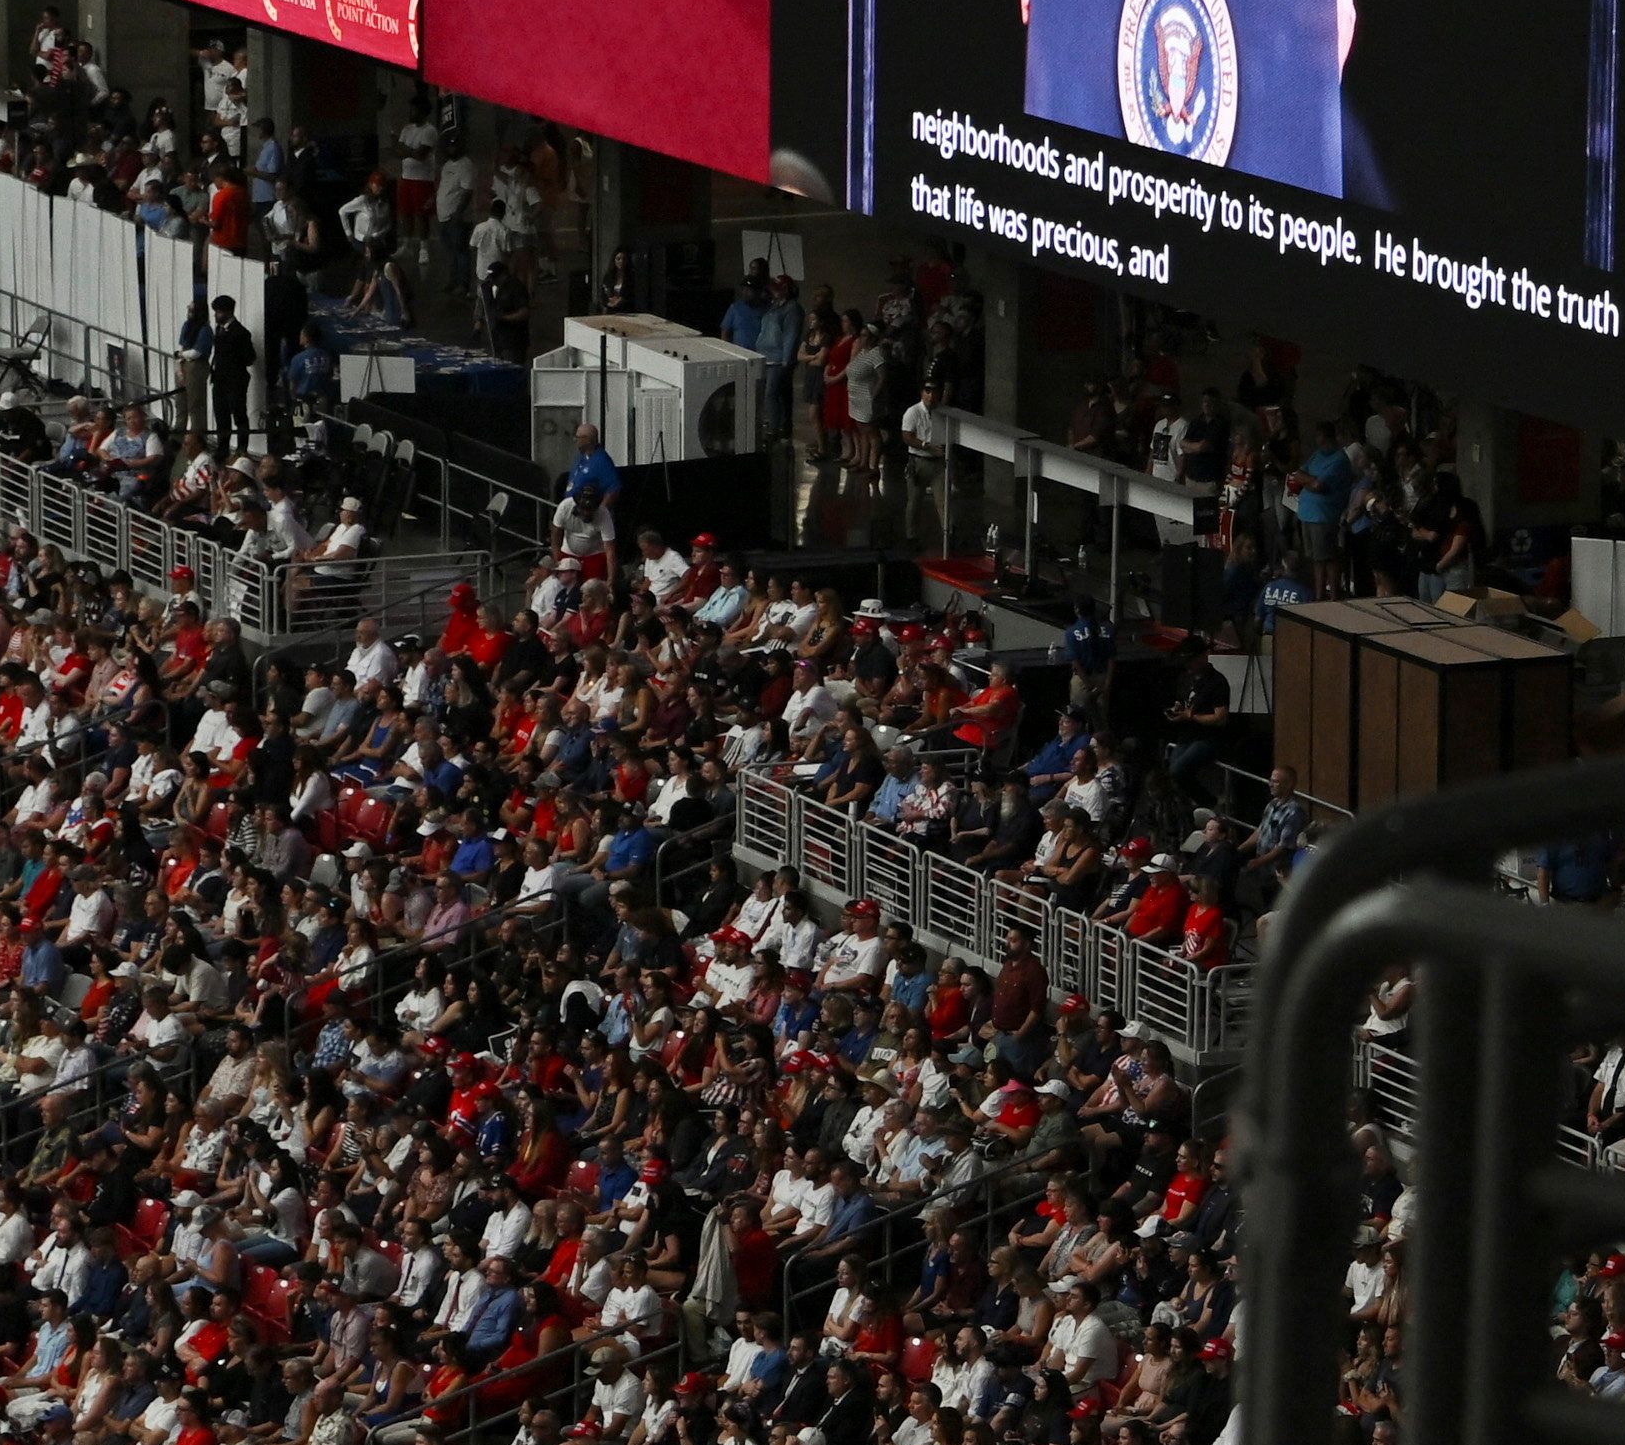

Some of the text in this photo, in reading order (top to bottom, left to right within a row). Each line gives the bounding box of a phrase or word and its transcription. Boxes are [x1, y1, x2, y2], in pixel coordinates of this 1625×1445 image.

[336, 2, 399, 35] POINT ACTION
[911, 109, 1619, 338] neighborhoods and prosperity to its people. He brought the truth
[911, 175, 1170, 285] that life was precious, and
